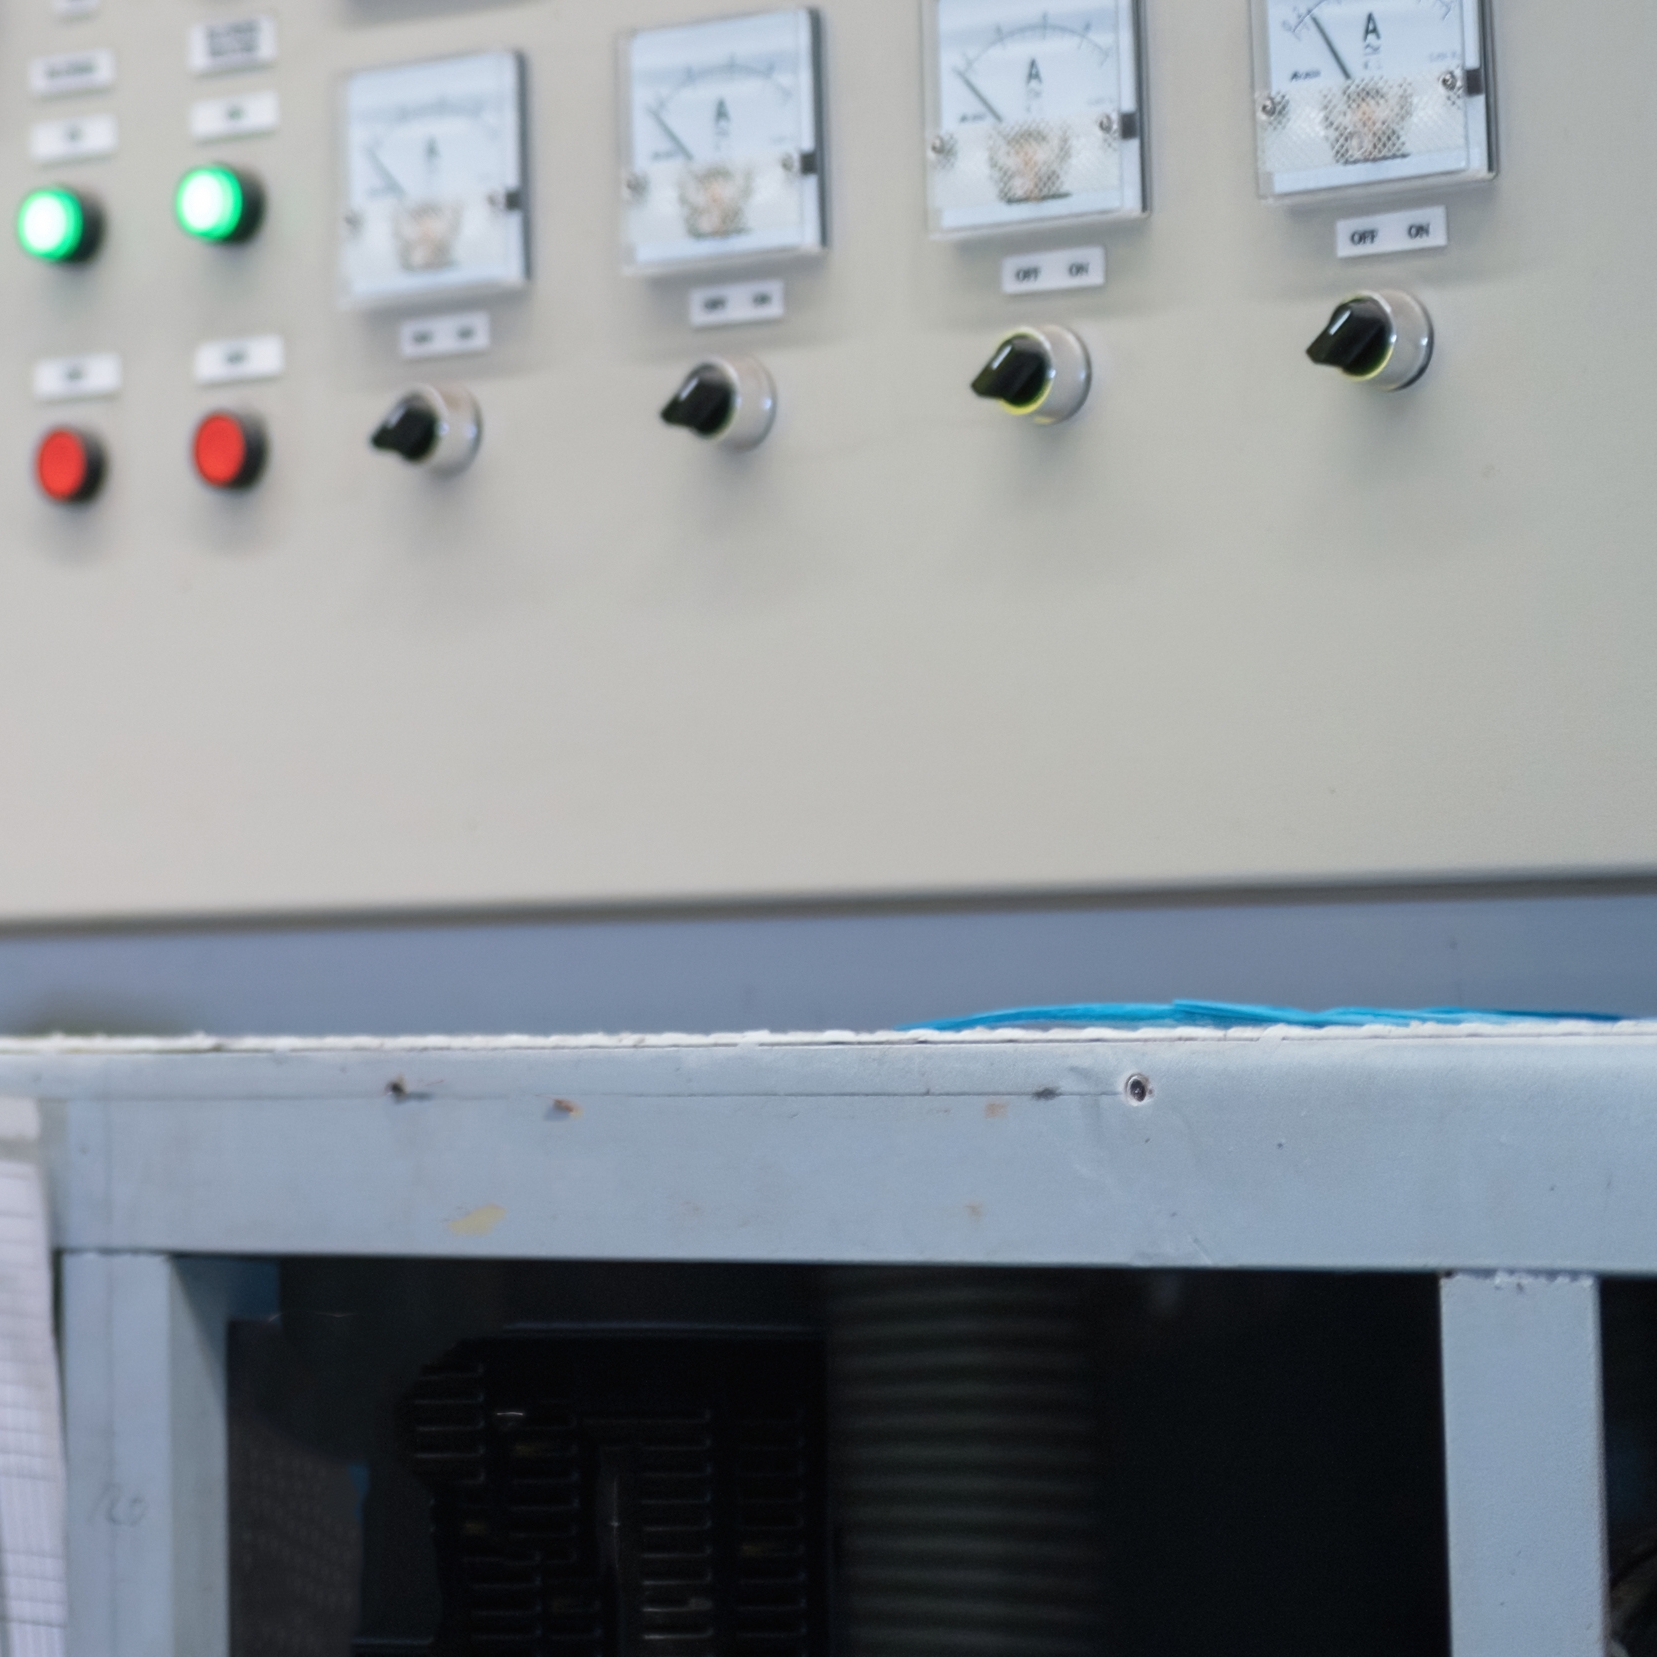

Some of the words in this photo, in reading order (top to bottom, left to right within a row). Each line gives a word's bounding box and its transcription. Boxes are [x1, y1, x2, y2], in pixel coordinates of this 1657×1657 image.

[1363, 11, 1381, 42] A
[1026, 58, 1043, 87] A
[1350, 227, 1379, 246] OFF
[1407, 222, 1431, 240] ON
